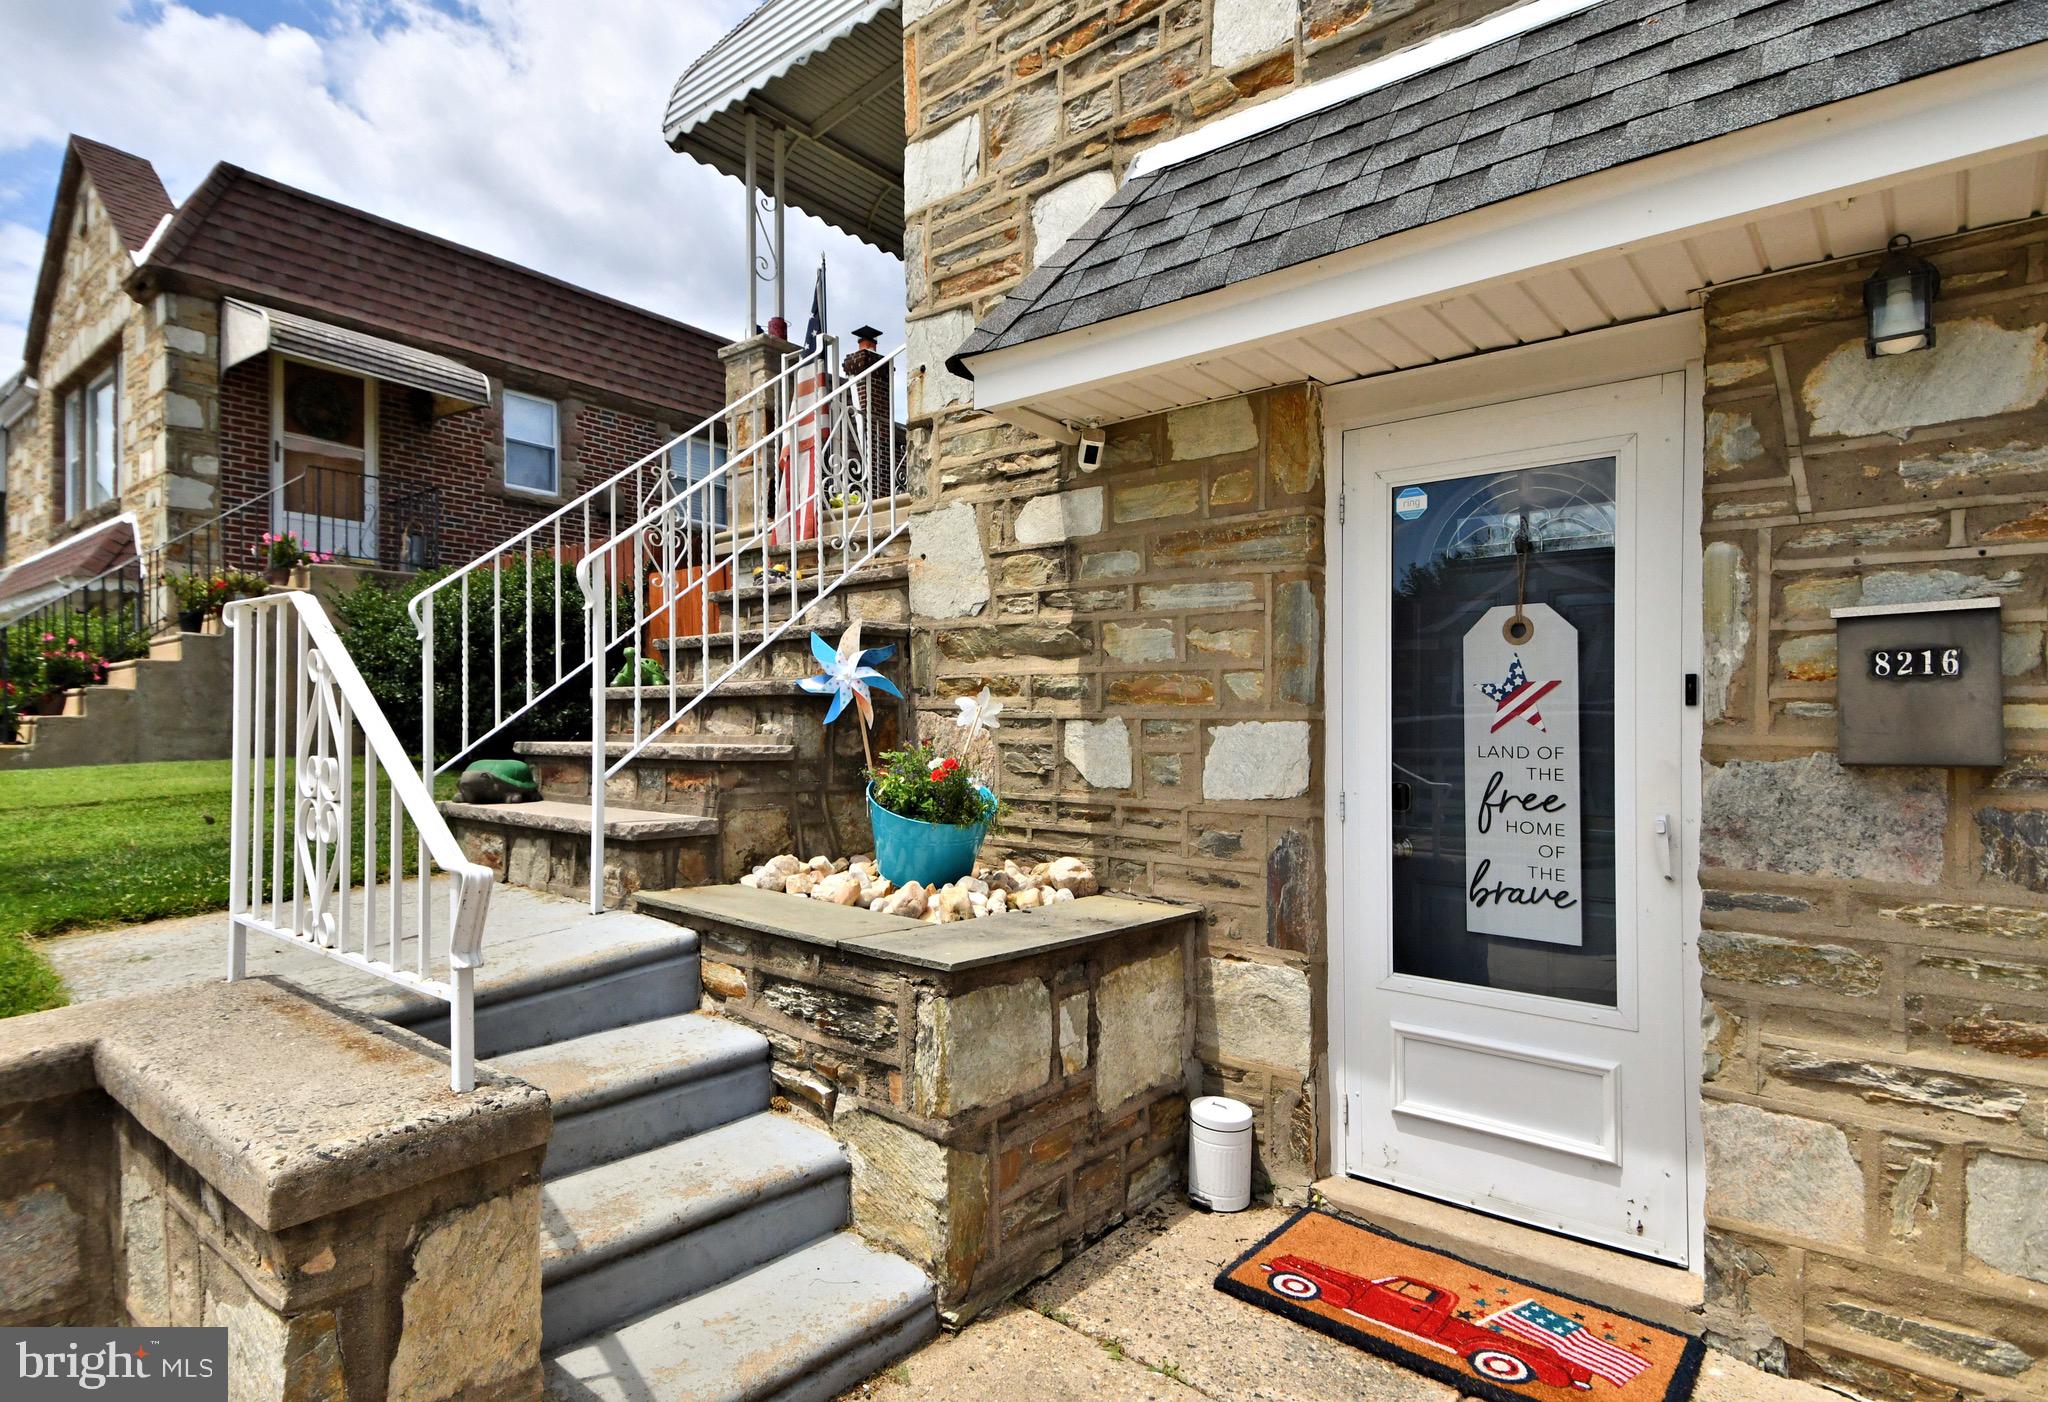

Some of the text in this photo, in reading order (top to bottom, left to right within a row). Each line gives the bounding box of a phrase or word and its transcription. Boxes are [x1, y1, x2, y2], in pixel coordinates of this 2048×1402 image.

[1875, 649, 1959, 676] 8216
[1477, 745, 1565, 760] LAND OF
[1526, 767, 1564, 782] THE
[1479, 771, 1566, 834] free
[1506, 820, 1565, 837] HOME
[1538, 844, 1565, 859] OF
[1527, 865, 1565, 882] THE
[1469, 859, 1577, 909] brave
